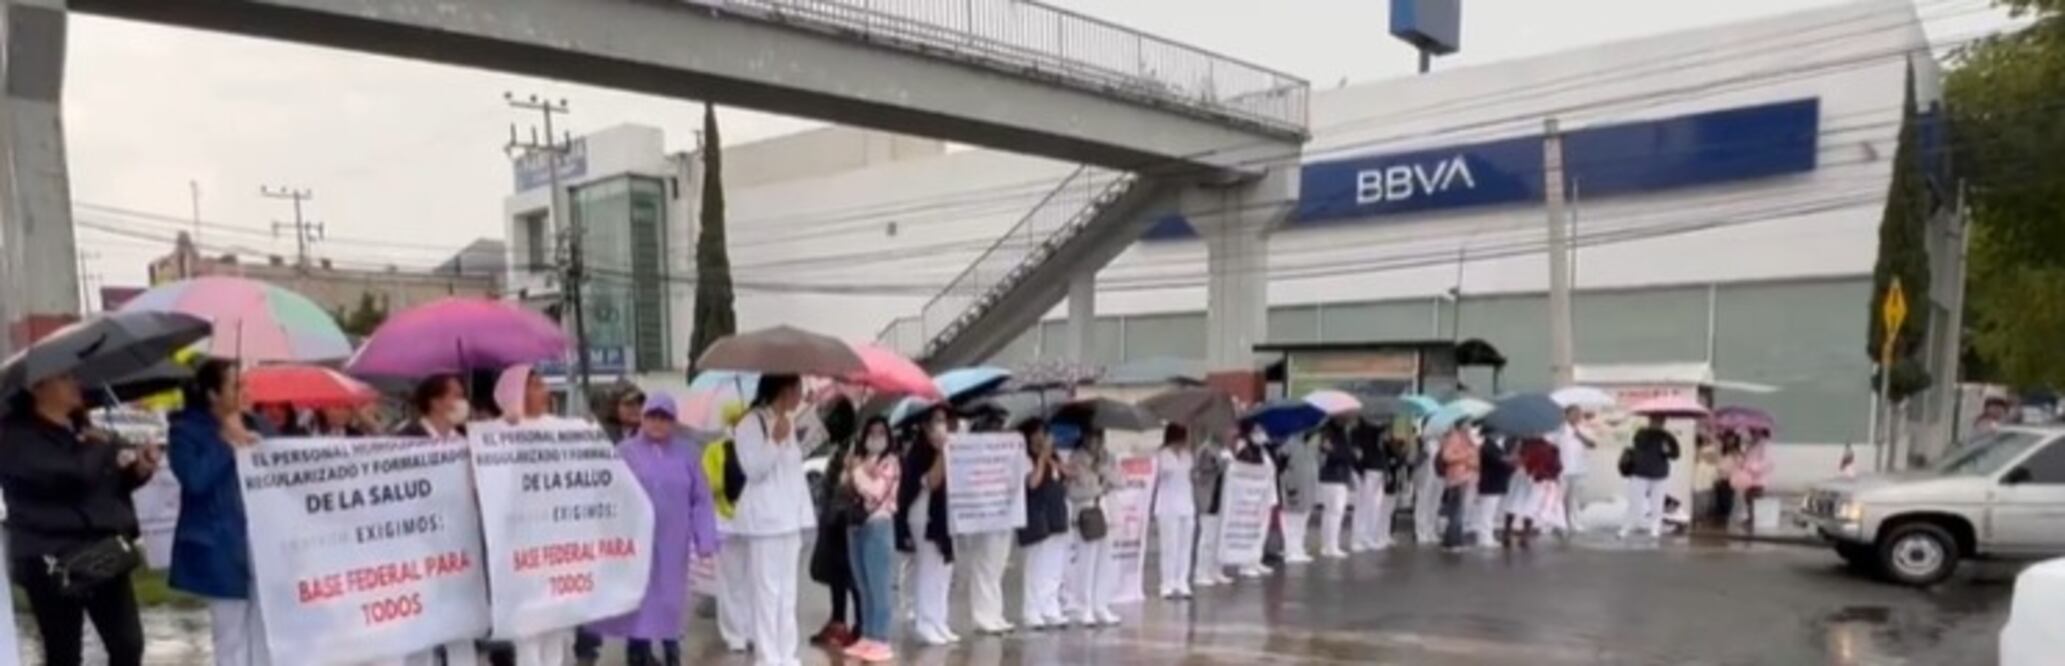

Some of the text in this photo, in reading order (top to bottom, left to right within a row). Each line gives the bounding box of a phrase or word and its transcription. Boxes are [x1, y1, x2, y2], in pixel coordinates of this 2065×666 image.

[1357, 155, 1475, 204] BBVA
[273, 447, 348, 466] PERSONAL
[246, 466, 359, 490] REGULARIZADO
[361, 462, 371, 476] Y
[522, 468, 613, 492] DE LA SALUD
[306, 479, 432, 514] DE LA SALUD
[356, 515, 444, 544] EXIGIMOS:
[543, 541, 594, 566] FEDERAL
[598, 537, 637, 557] PARA
[298, 551, 471, 603] BASE FEDERAL PARA
[549, 571, 595, 596] TODOS
[361, 593, 423, 625] TODOS
